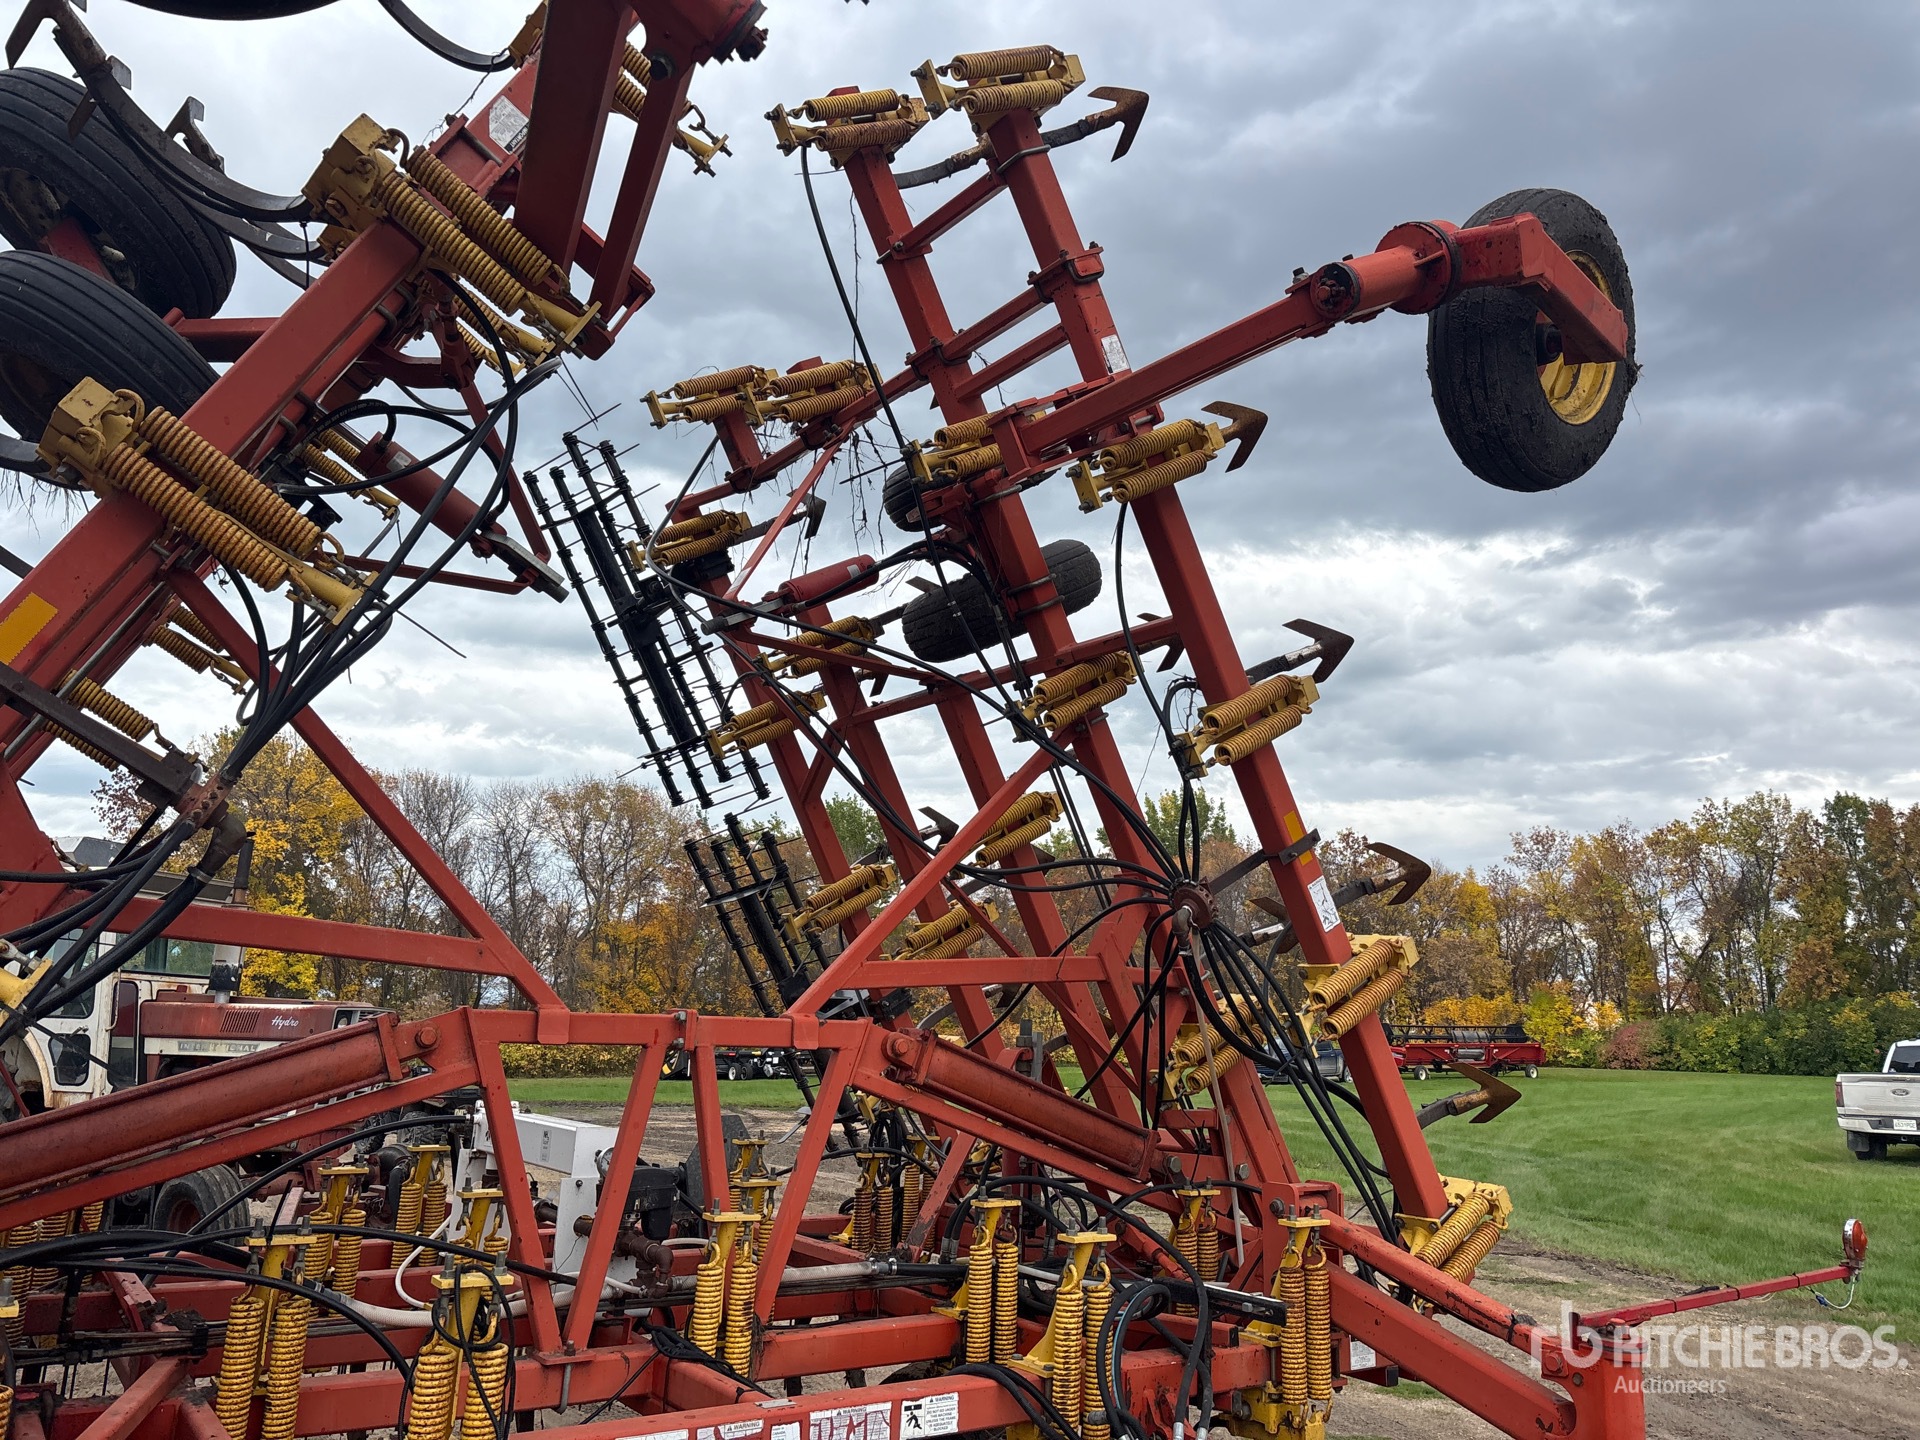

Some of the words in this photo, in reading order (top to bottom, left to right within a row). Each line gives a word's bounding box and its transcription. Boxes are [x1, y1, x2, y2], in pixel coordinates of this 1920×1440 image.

[272, 1015, 299, 1030] Hydro
[842, 1407, 867, 1415] WARNING
[733, 1422, 760, 1430] WARNING
